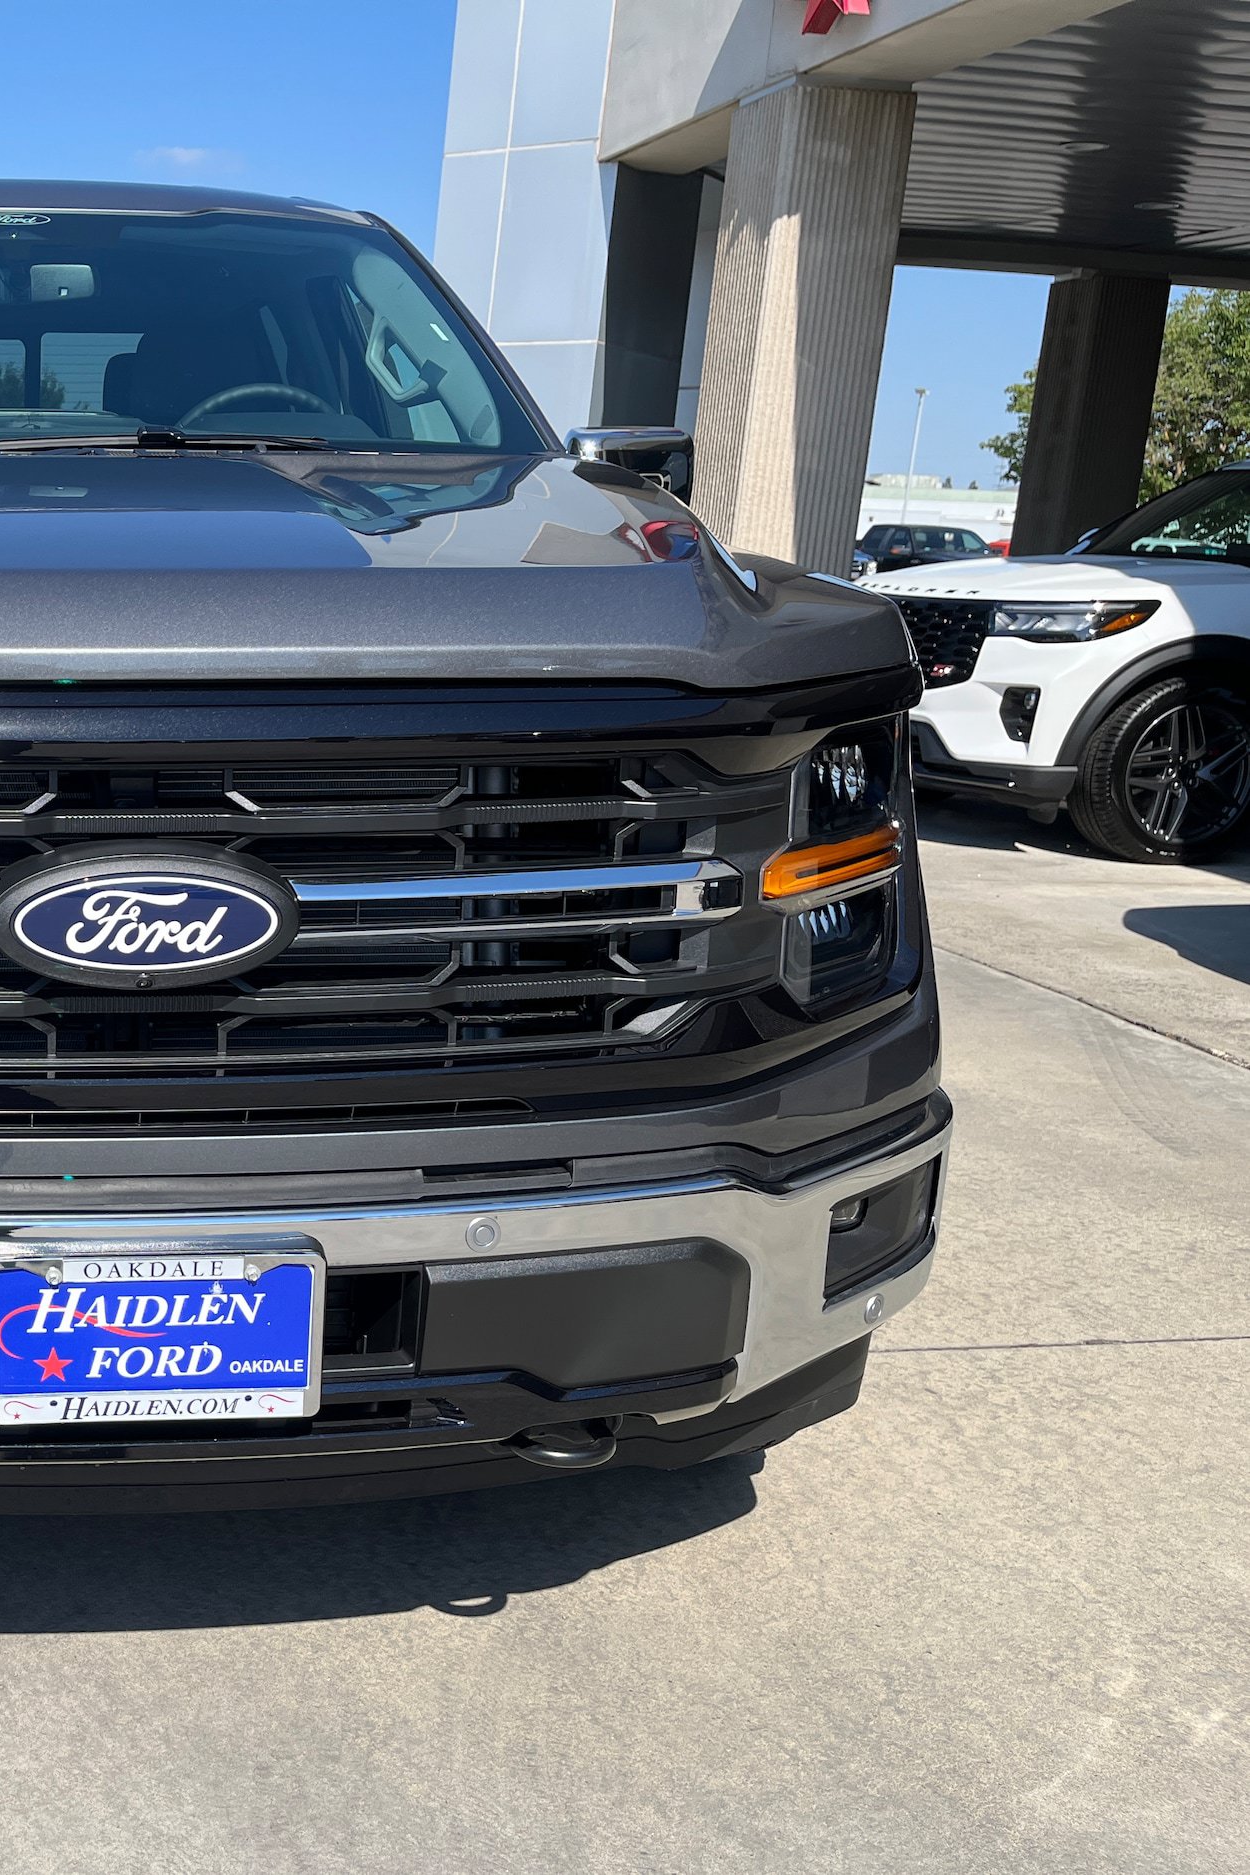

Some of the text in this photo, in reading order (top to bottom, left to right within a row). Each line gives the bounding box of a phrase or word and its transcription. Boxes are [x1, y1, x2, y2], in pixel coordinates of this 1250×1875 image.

[64, 889, 229, 955] Ford
[83, 1260, 225, 1280] OAKDALE
[26, 1287, 268, 1335] HAIDLEN
[85, 1343, 304, 1379] FORD OAKDALE
[60, 1396, 239, 1421] HAIDLEN.COM
